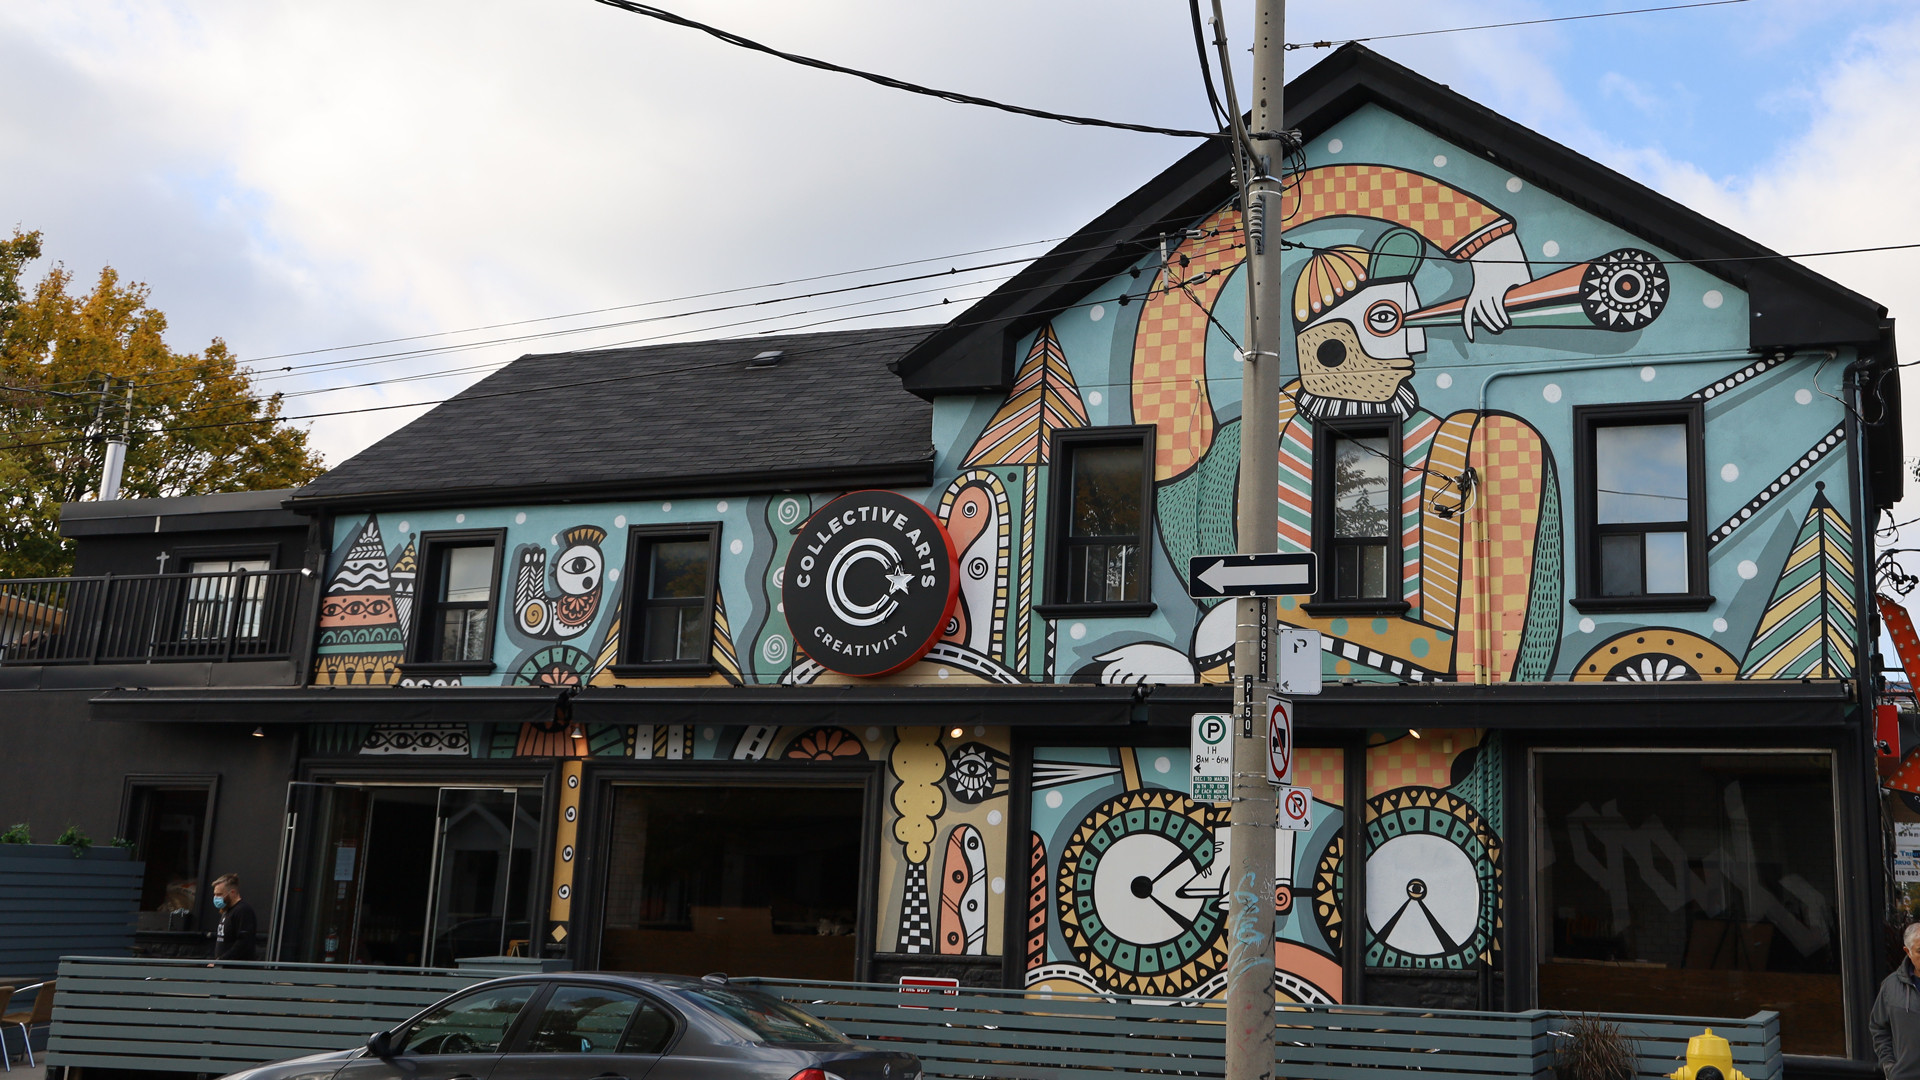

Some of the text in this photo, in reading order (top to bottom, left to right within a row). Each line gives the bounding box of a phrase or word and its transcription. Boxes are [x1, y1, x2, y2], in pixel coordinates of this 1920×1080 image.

[796, 506, 936, 588] COLLECTIVE ARTS
[813, 625, 908, 657] CREATIVITY
[1207, 722, 1220, 738] P
